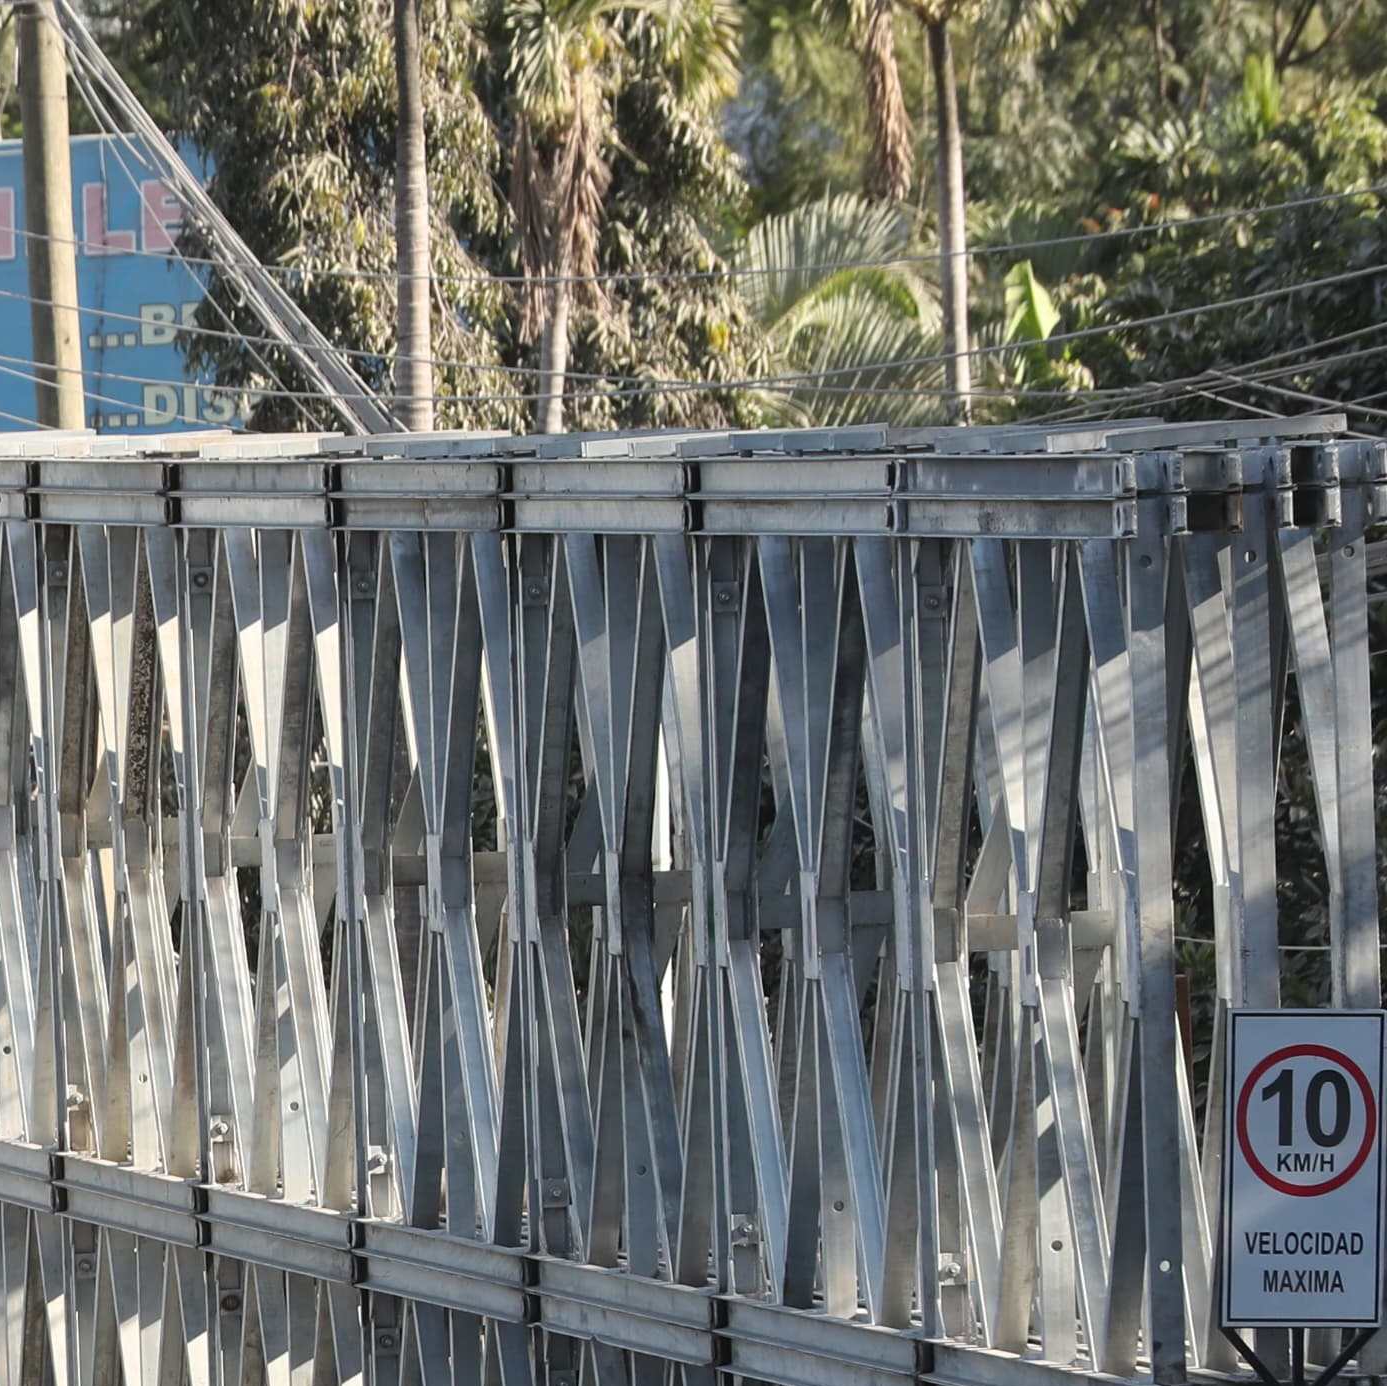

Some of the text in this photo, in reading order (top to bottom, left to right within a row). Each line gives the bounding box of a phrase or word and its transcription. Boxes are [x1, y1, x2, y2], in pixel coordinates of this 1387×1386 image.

[1261, 1068, 1352, 1148] 10
[1277, 1152, 1335, 1172] KM/H
[1245, 1231, 1364, 1256] VELOCIDAD
[1263, 1269, 1345, 1293] MAXIMA
